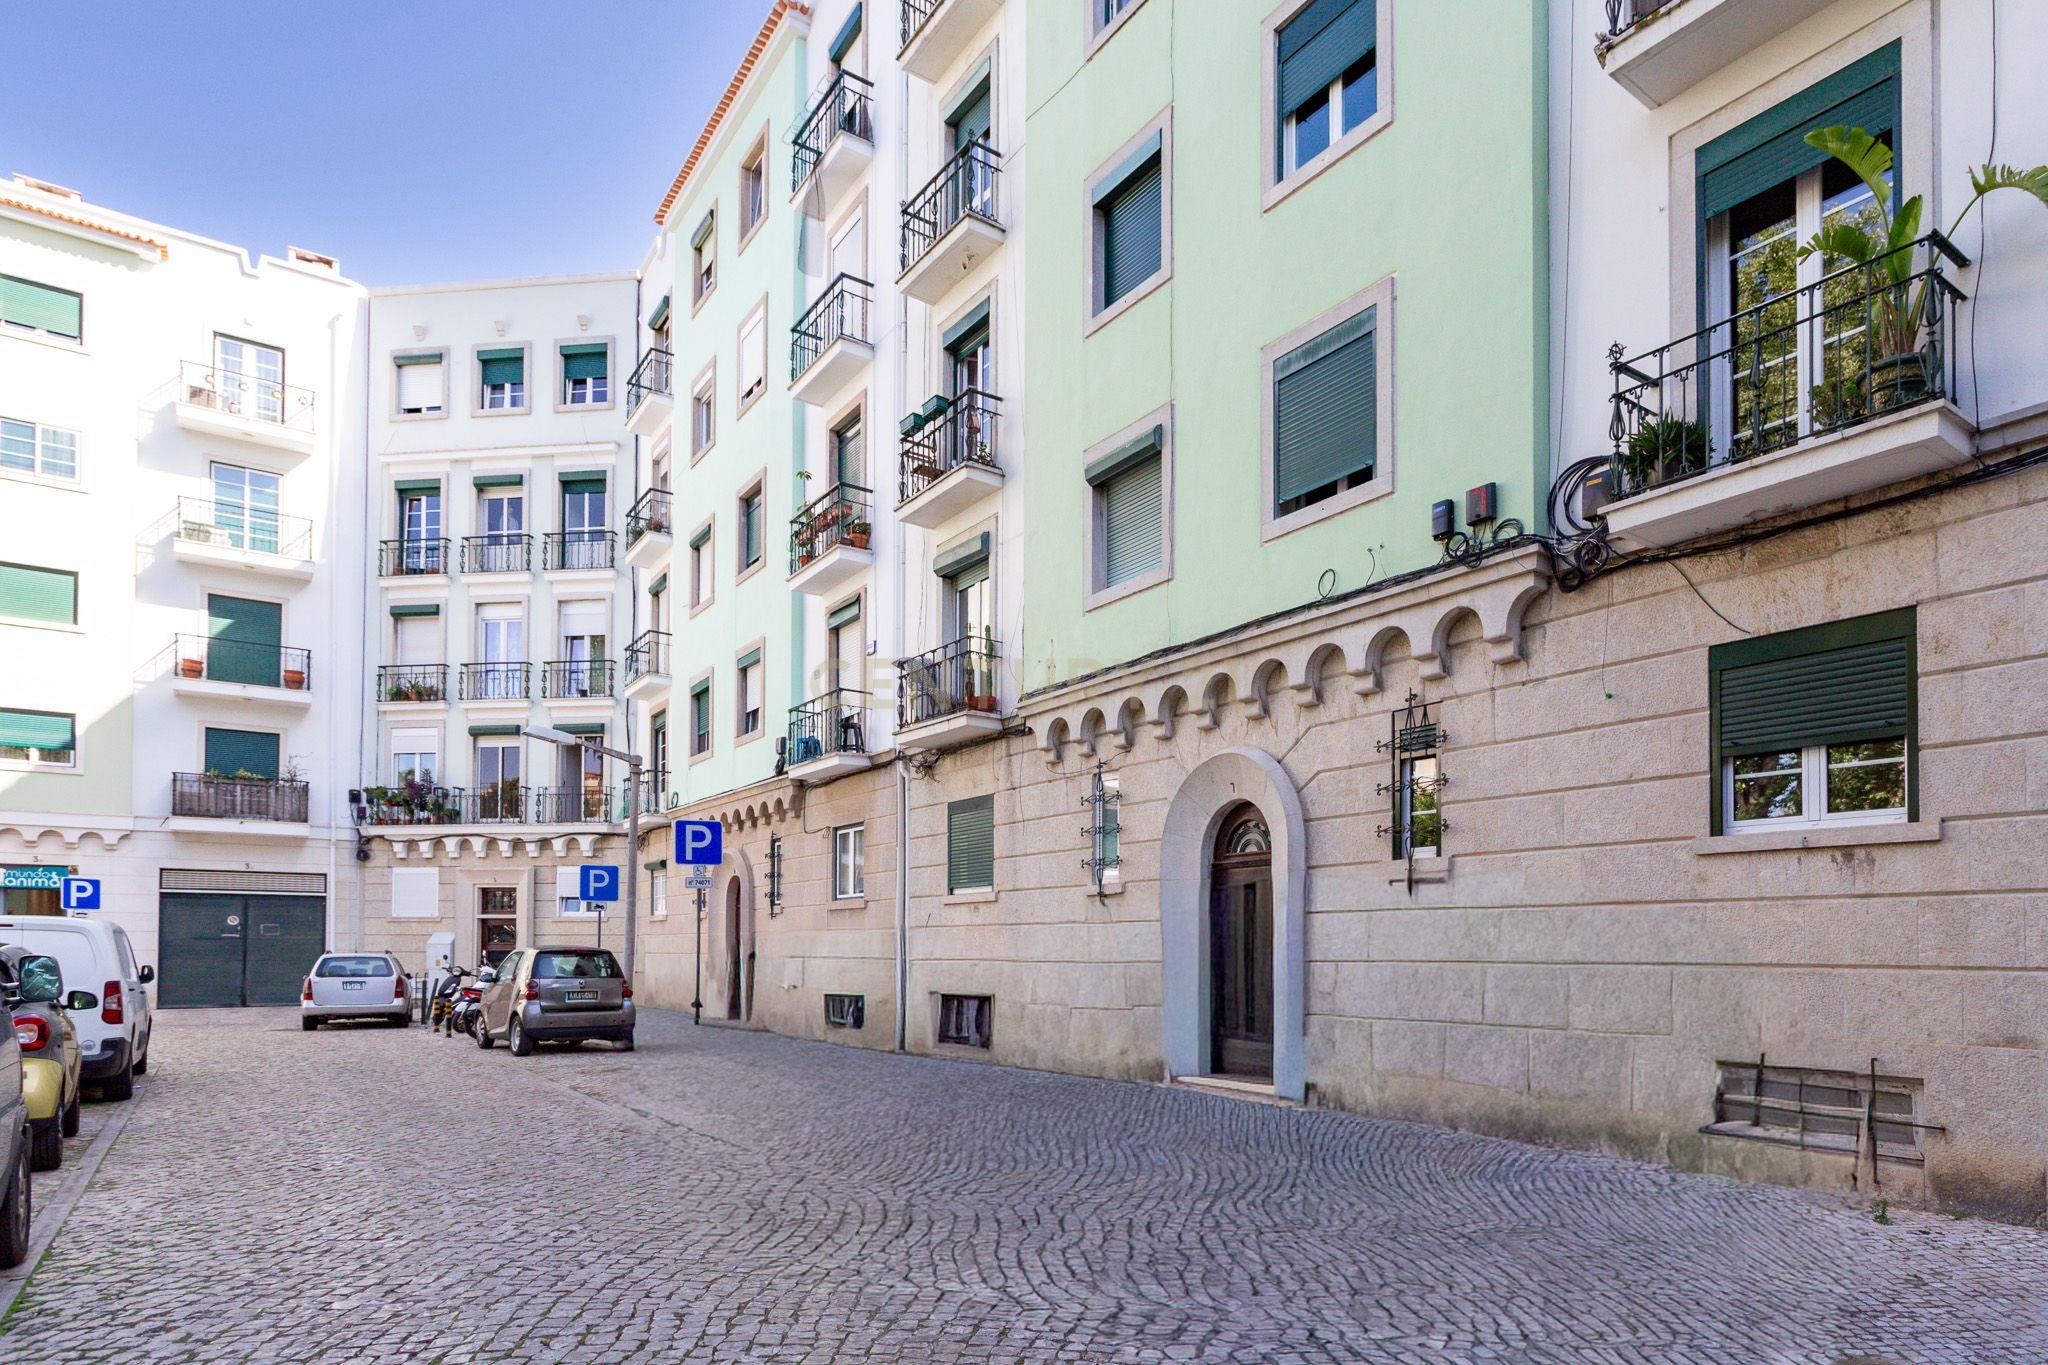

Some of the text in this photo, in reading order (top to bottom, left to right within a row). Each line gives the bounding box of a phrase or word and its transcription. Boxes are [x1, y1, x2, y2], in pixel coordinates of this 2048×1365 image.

[685, 824, 712, 861] P
[5, 868, 50, 878] mundo
[5, 876, 62, 888] anima
[589, 869, 610, 897] P
[70, 880, 94, 907] P
